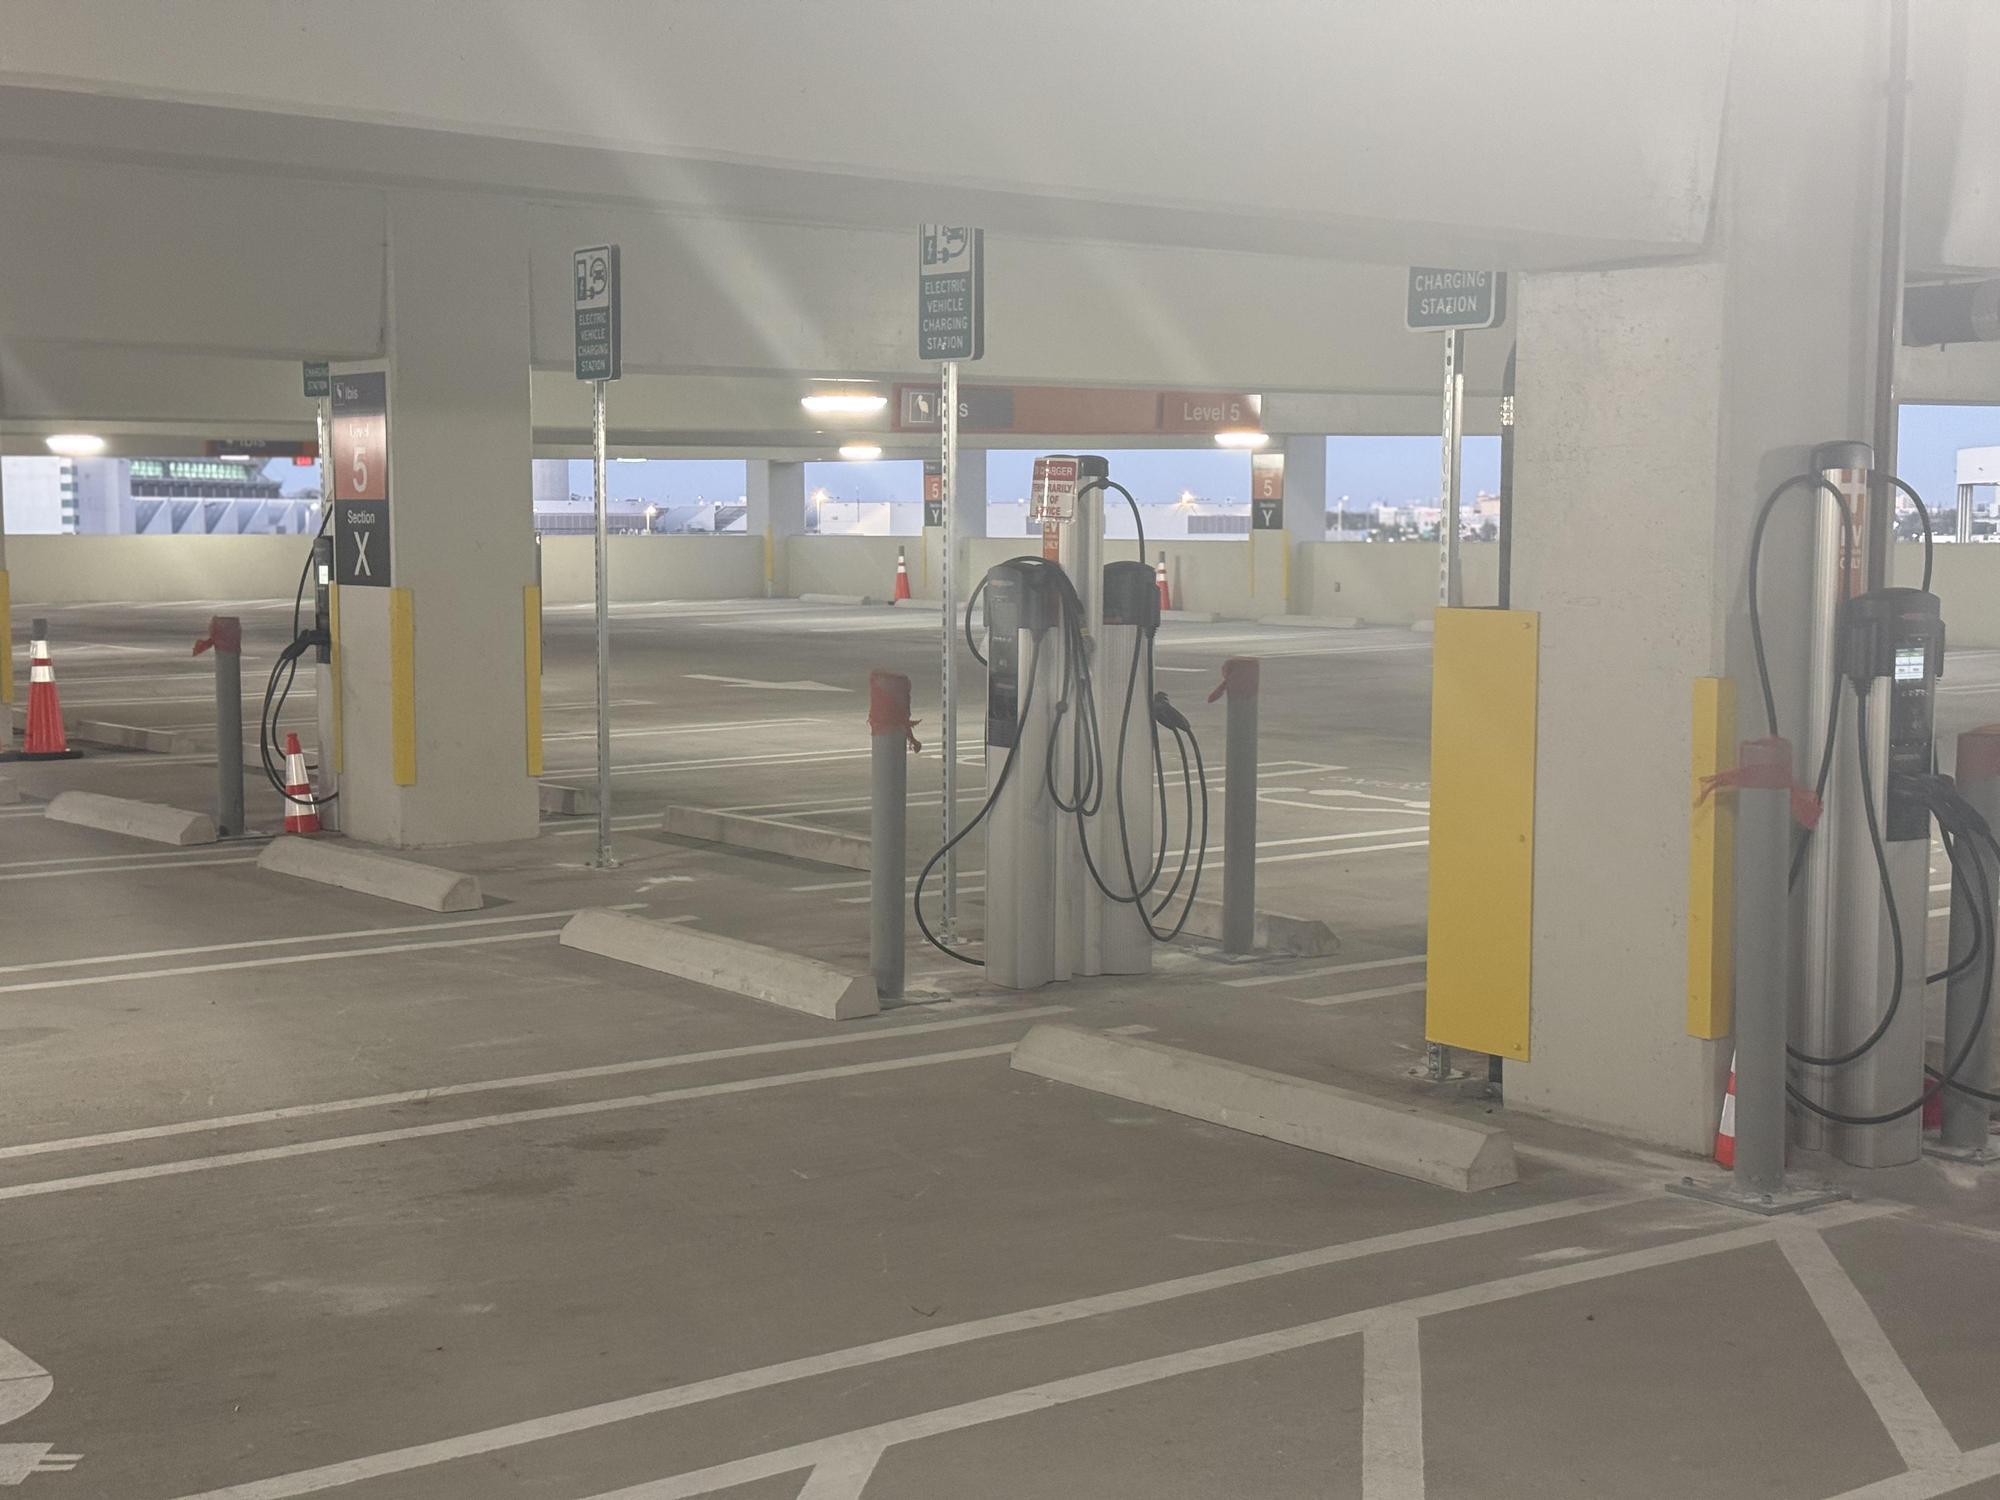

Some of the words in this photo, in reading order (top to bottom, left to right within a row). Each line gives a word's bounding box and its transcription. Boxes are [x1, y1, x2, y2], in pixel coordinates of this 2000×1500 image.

[924, 279, 966, 295] ELECTRIC
[1415, 271, 1486, 291] CHARGING
[927, 298, 964, 312] VEHICLE
[1420, 296, 1477, 314] STATION
[579, 312, 607, 325] ELECTRIC
[922, 316, 968, 332] CHARGING
[581, 328, 606, 341] VEHICLE
[578, 343, 608, 356] CHARGING
[927, 336, 963, 350] STATION
[580, 360, 606, 372] STATION
[937, 398, 968, 417] Is
[1183, 402, 1225, 421] Level
[1230, 403, 1240, 421] 5
[353, 446, 368, 493] 5
[932, 482, 939, 498] 5
[1263, 480, 1273, 497] 5
[347, 510, 375, 524] Section
[932, 509, 940, 524] Y
[1262, 510, 1273, 527] Y
[354, 531, 371, 576] X
